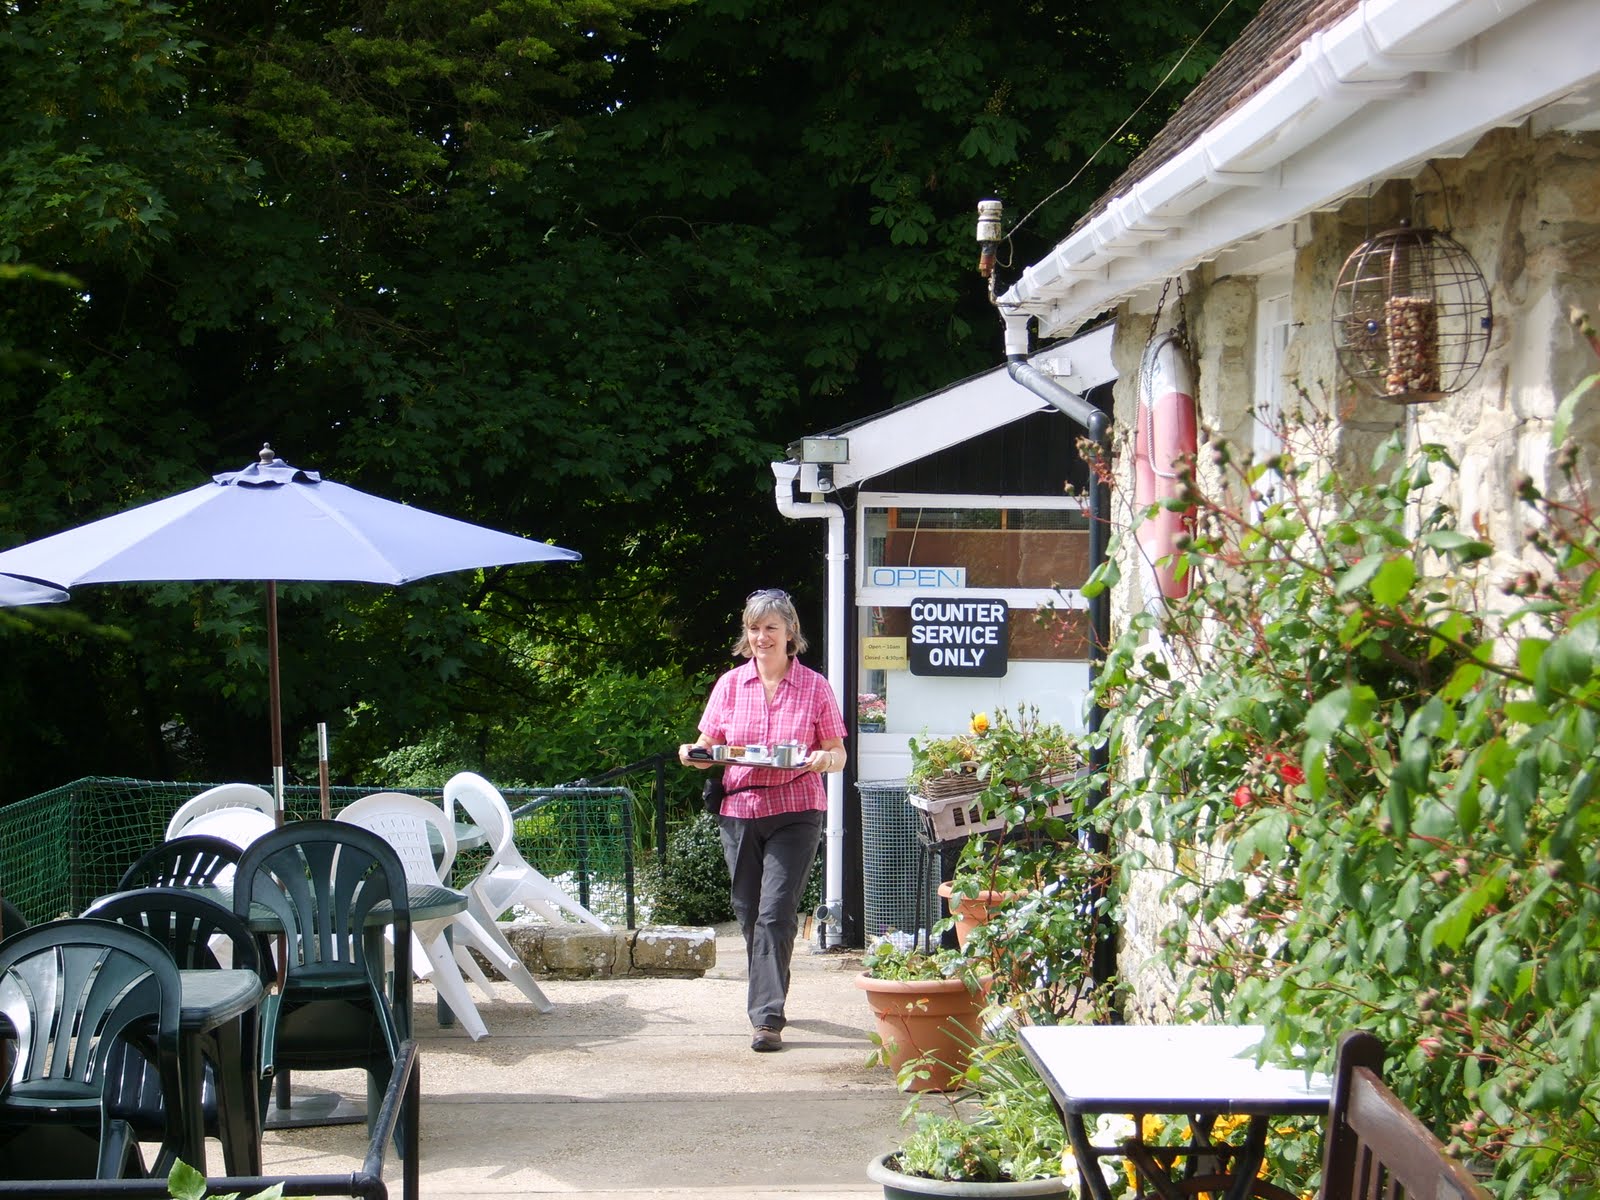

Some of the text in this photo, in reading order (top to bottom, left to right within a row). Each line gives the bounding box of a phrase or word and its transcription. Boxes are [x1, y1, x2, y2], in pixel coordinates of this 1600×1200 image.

[873, 568, 960, 587] OPEN
[910, 603, 1004, 622] COUNTER
[911, 626, 998, 644] SERVICE
[929, 648, 984, 666] ONLY
